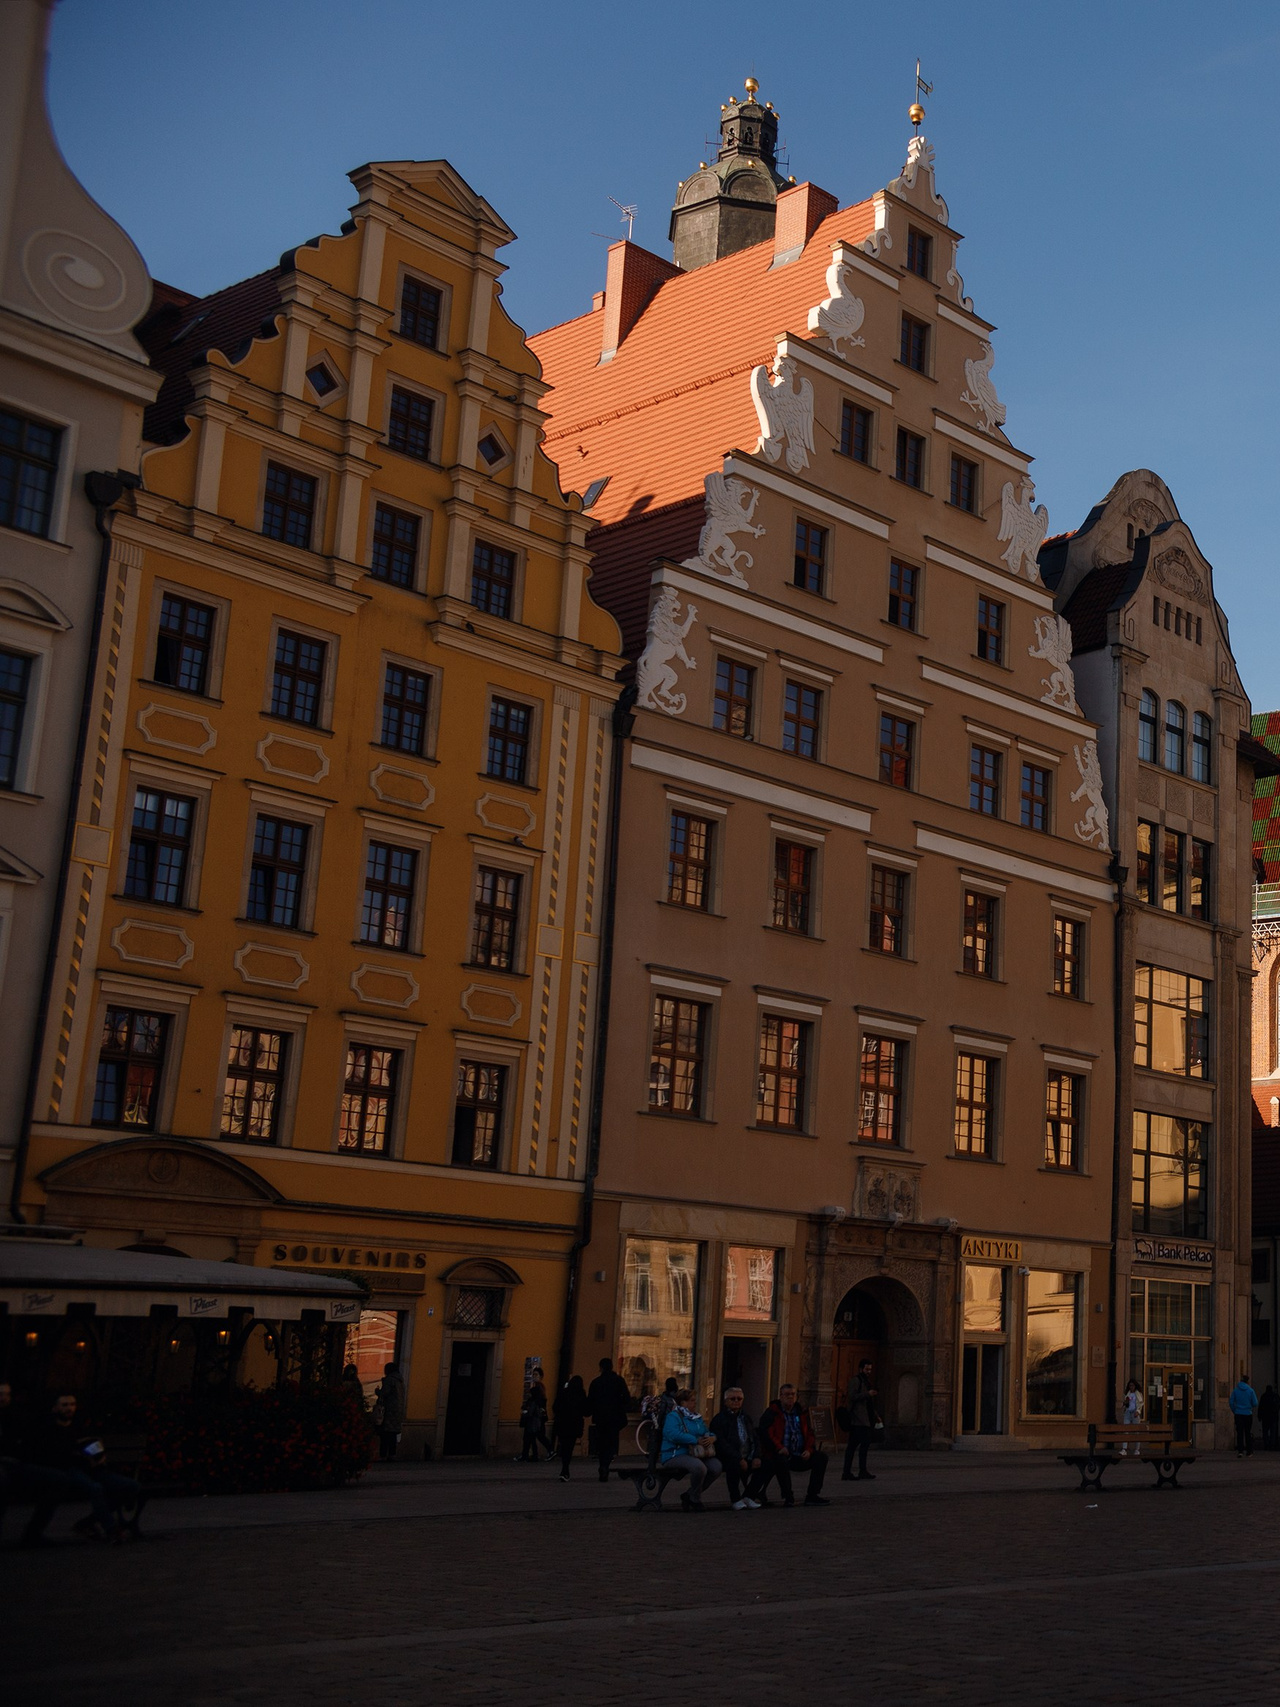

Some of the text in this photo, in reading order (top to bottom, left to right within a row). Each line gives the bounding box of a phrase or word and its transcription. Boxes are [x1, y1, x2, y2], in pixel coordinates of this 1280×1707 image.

[274, 1244, 427, 1269] SOUVENIRS
[962, 1238, 1020, 1260] ANTYKI
[1157, 1243, 1213, 1263] Bank Pekao
[193, 1297, 218, 1312] Piast
[333, 1302, 356, 1316] Piast
